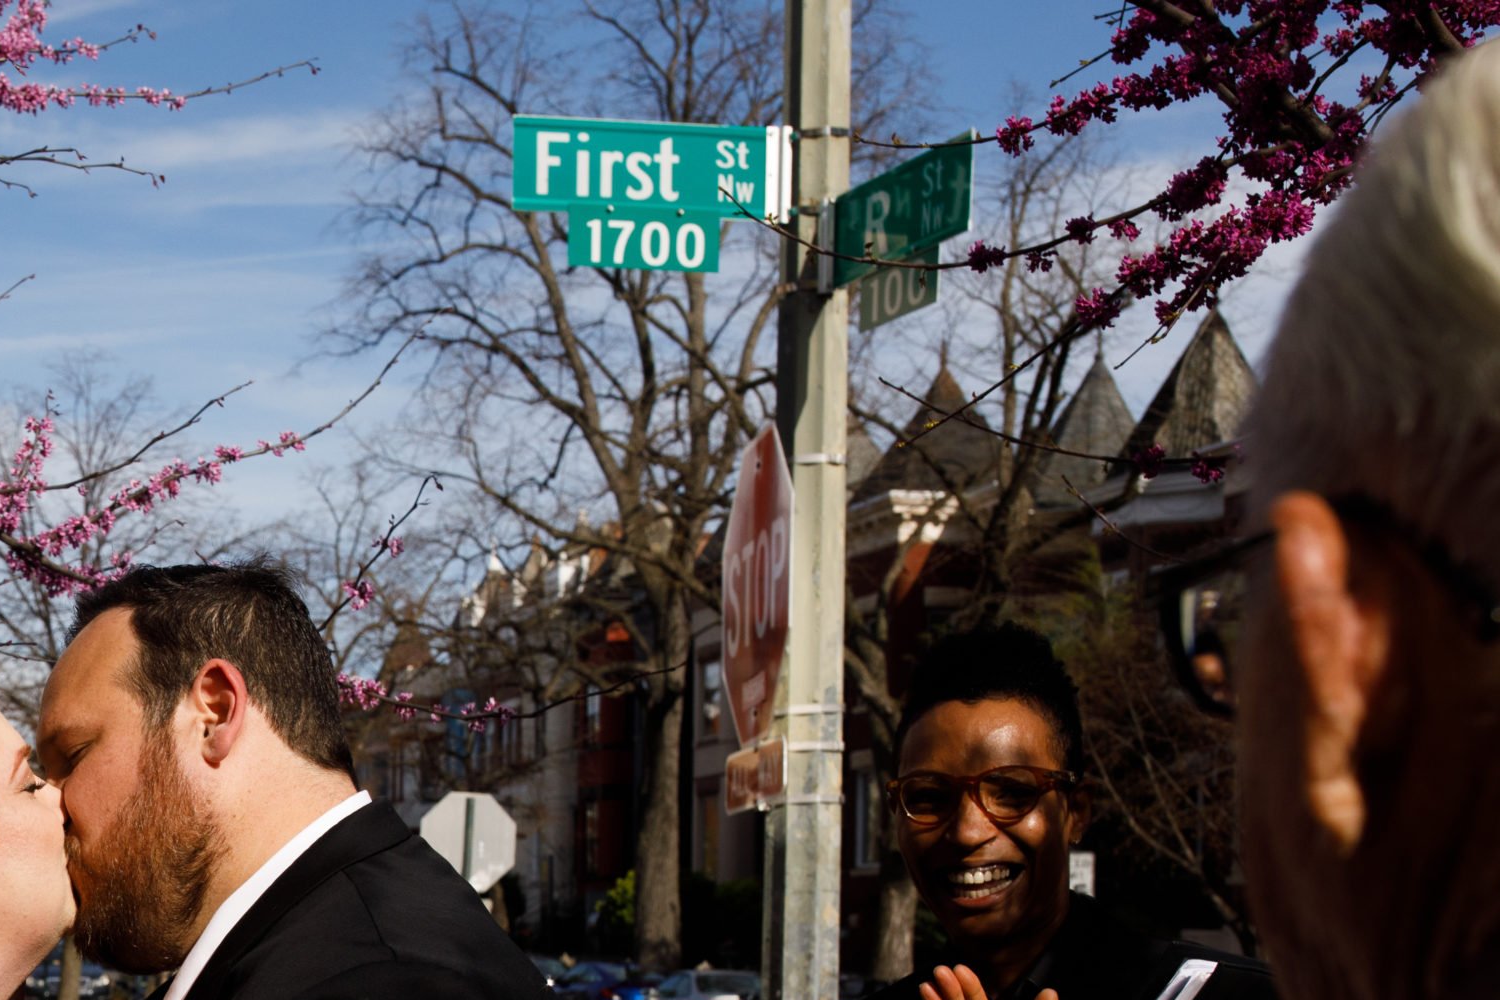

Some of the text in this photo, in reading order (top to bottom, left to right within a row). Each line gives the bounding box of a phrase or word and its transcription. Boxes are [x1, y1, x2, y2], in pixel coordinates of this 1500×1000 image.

[535, 131, 750, 202] First St
[586, 218, 706, 269] 1700
[863, 160, 944, 257] R St
[869, 259, 928, 323] 100
[726, 515, 786, 658] STOP
